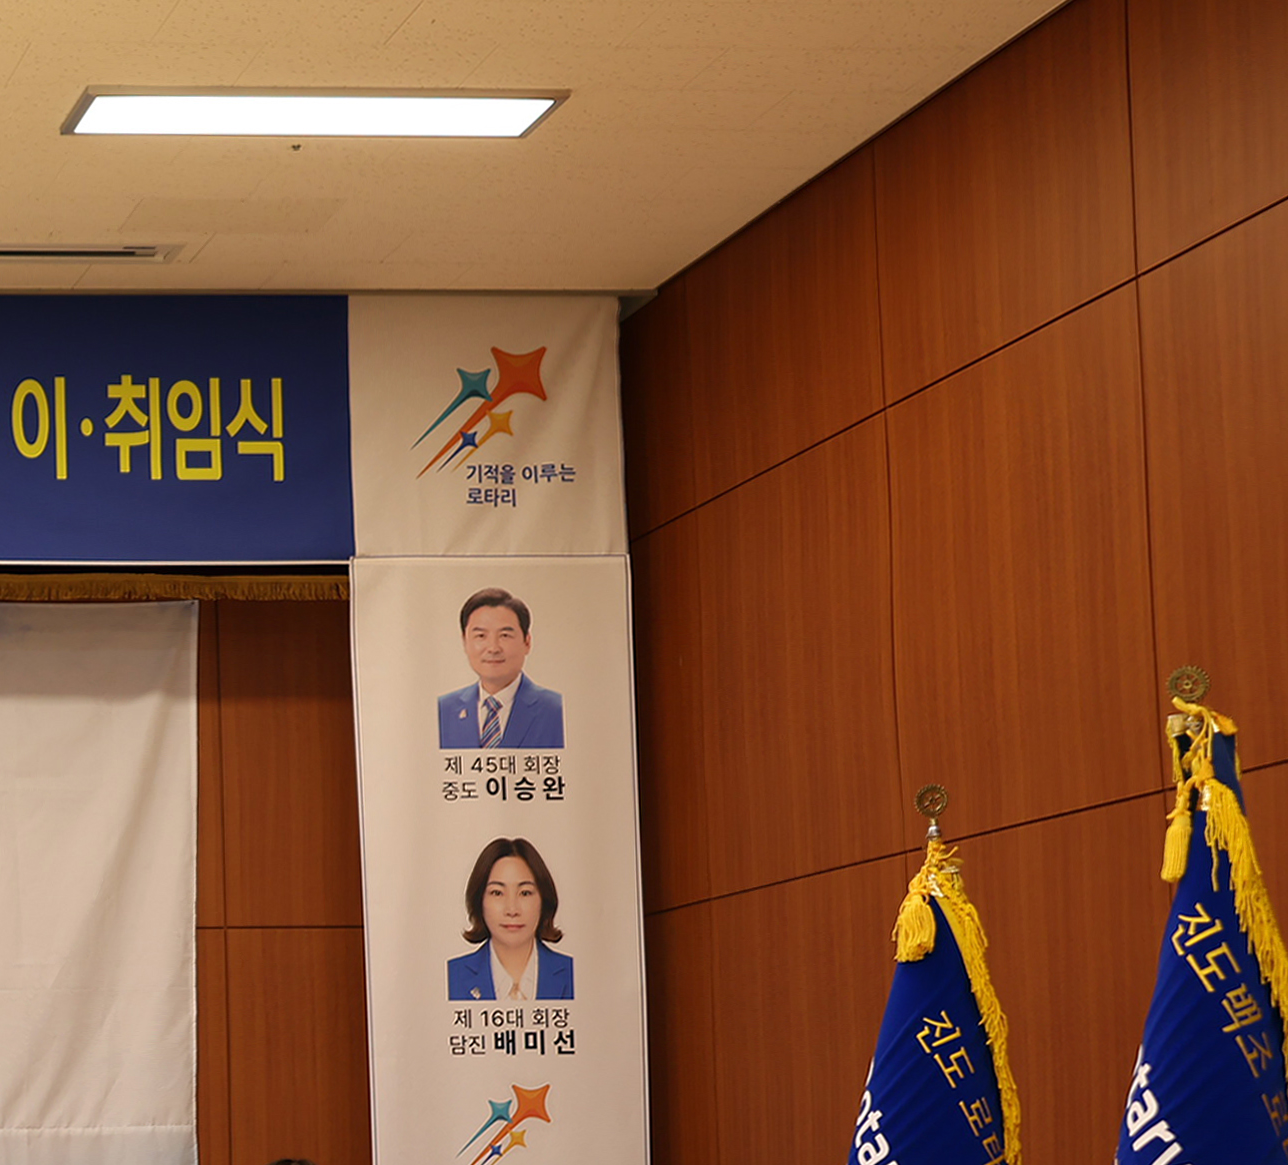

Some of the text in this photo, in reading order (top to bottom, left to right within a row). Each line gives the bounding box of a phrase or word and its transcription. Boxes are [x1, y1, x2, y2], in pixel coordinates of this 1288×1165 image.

[466, 463, 577, 485] 기적을 이루는
[466, 488, 517, 508] 로타리
[444, 755, 561, 775] 제 45대 회장
[442, 781, 479, 801] 중도
[454, 1008, 570, 1028] 제 16대 회장
[916, 1010, 975, 1088] 진도
